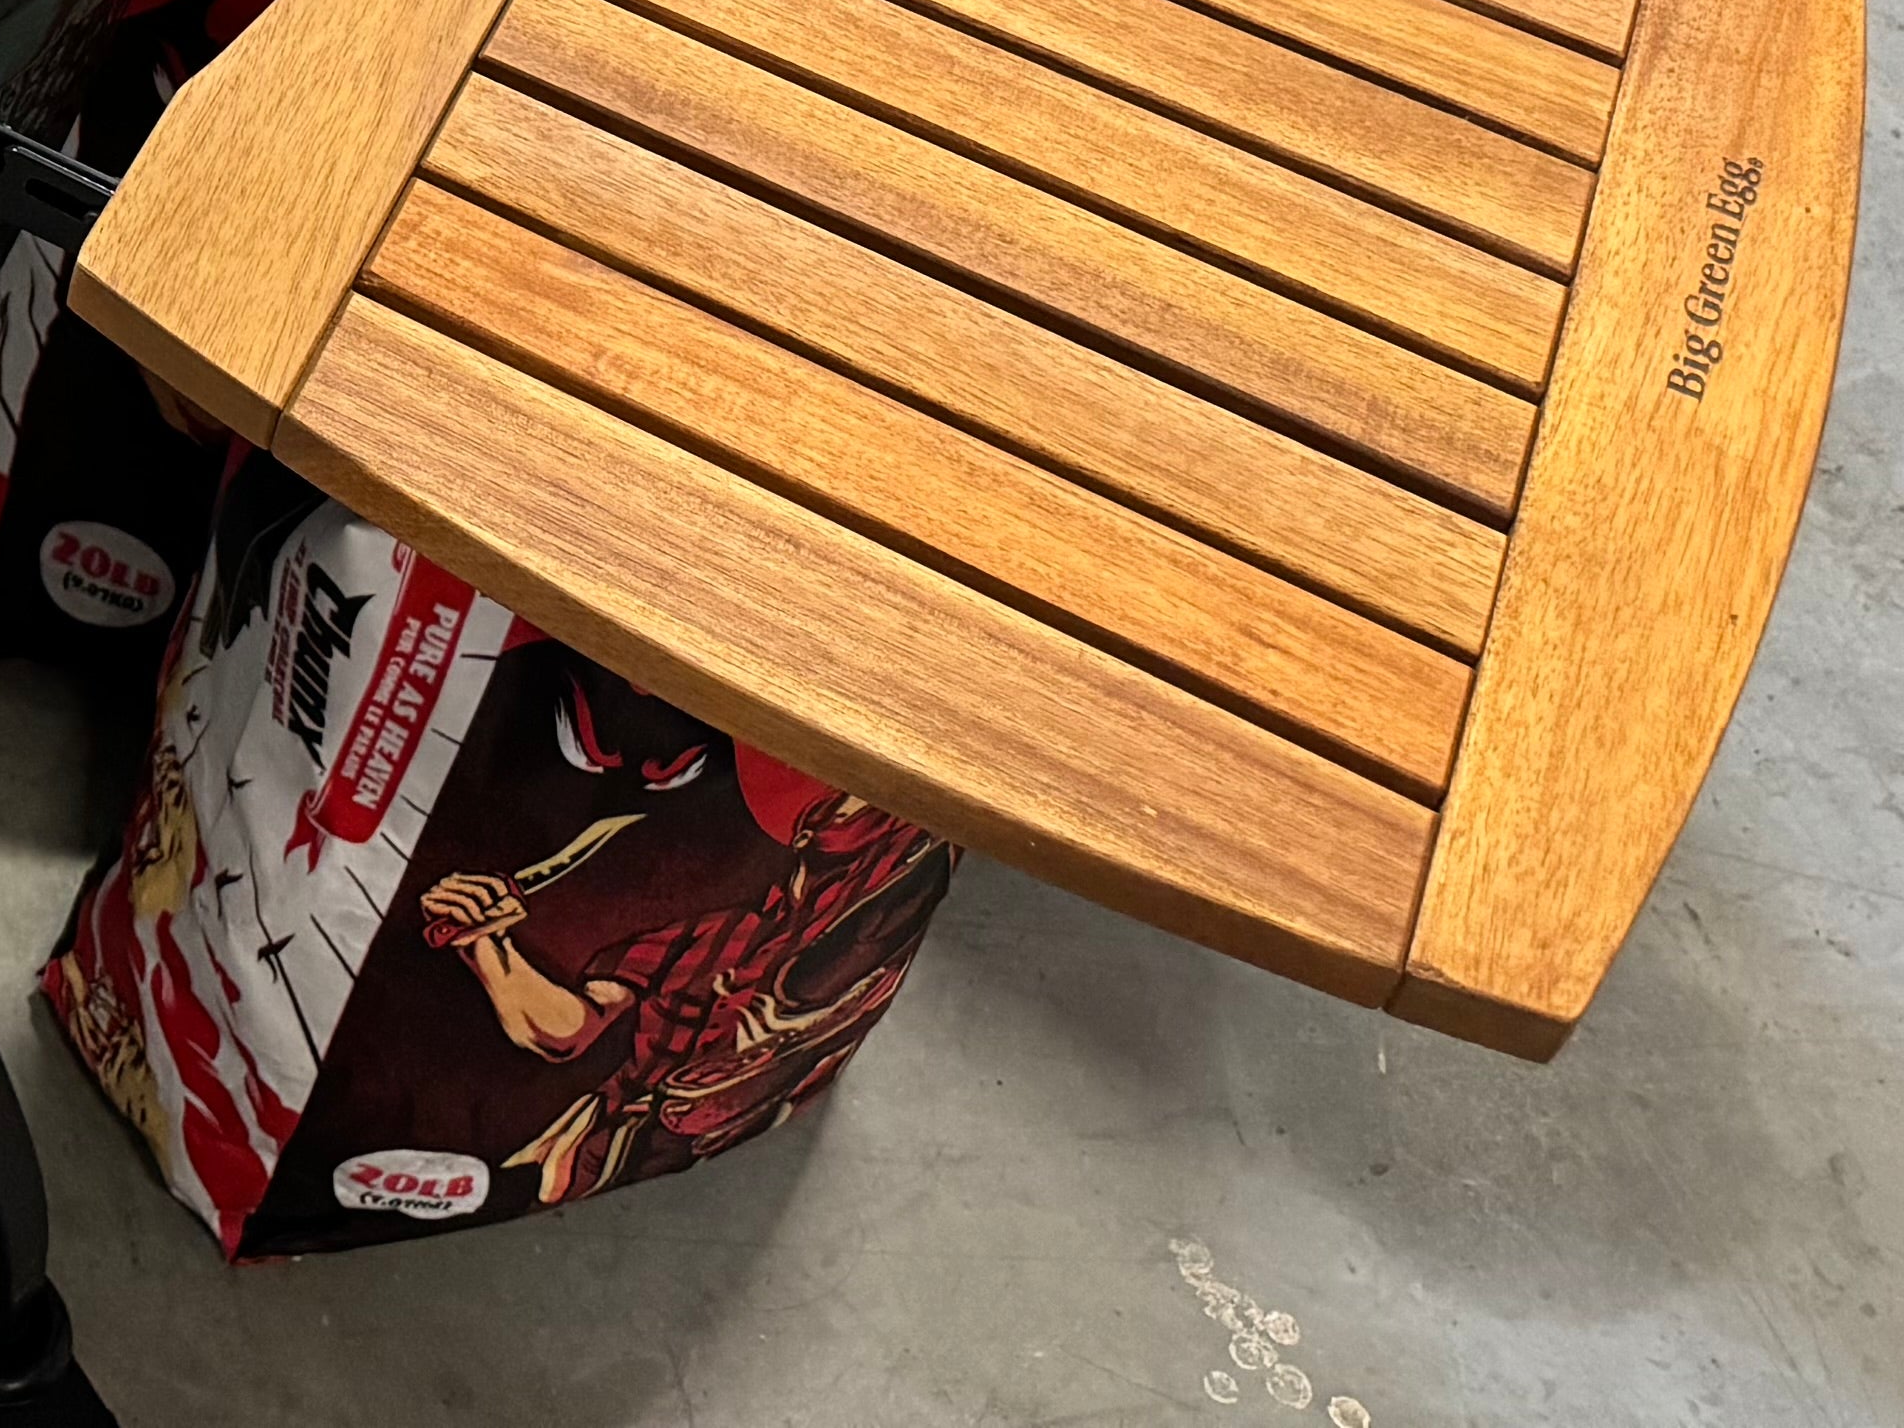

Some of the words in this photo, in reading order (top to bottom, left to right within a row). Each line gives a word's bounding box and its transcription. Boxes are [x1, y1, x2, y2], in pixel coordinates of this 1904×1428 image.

[1706, 156, 1763, 222] Egg
[1684, 222, 1740, 327] Green
[1666, 329, 1723, 403] Big
[51, 531, 160, 595] 20LB
[288, 562, 376, 775] Chunx
[409, 602, 460, 684] PURE
[393, 685, 424, 724] AS
[352, 719, 410, 810] HEAVEN
[350, 1163, 474, 1199] 20LB
